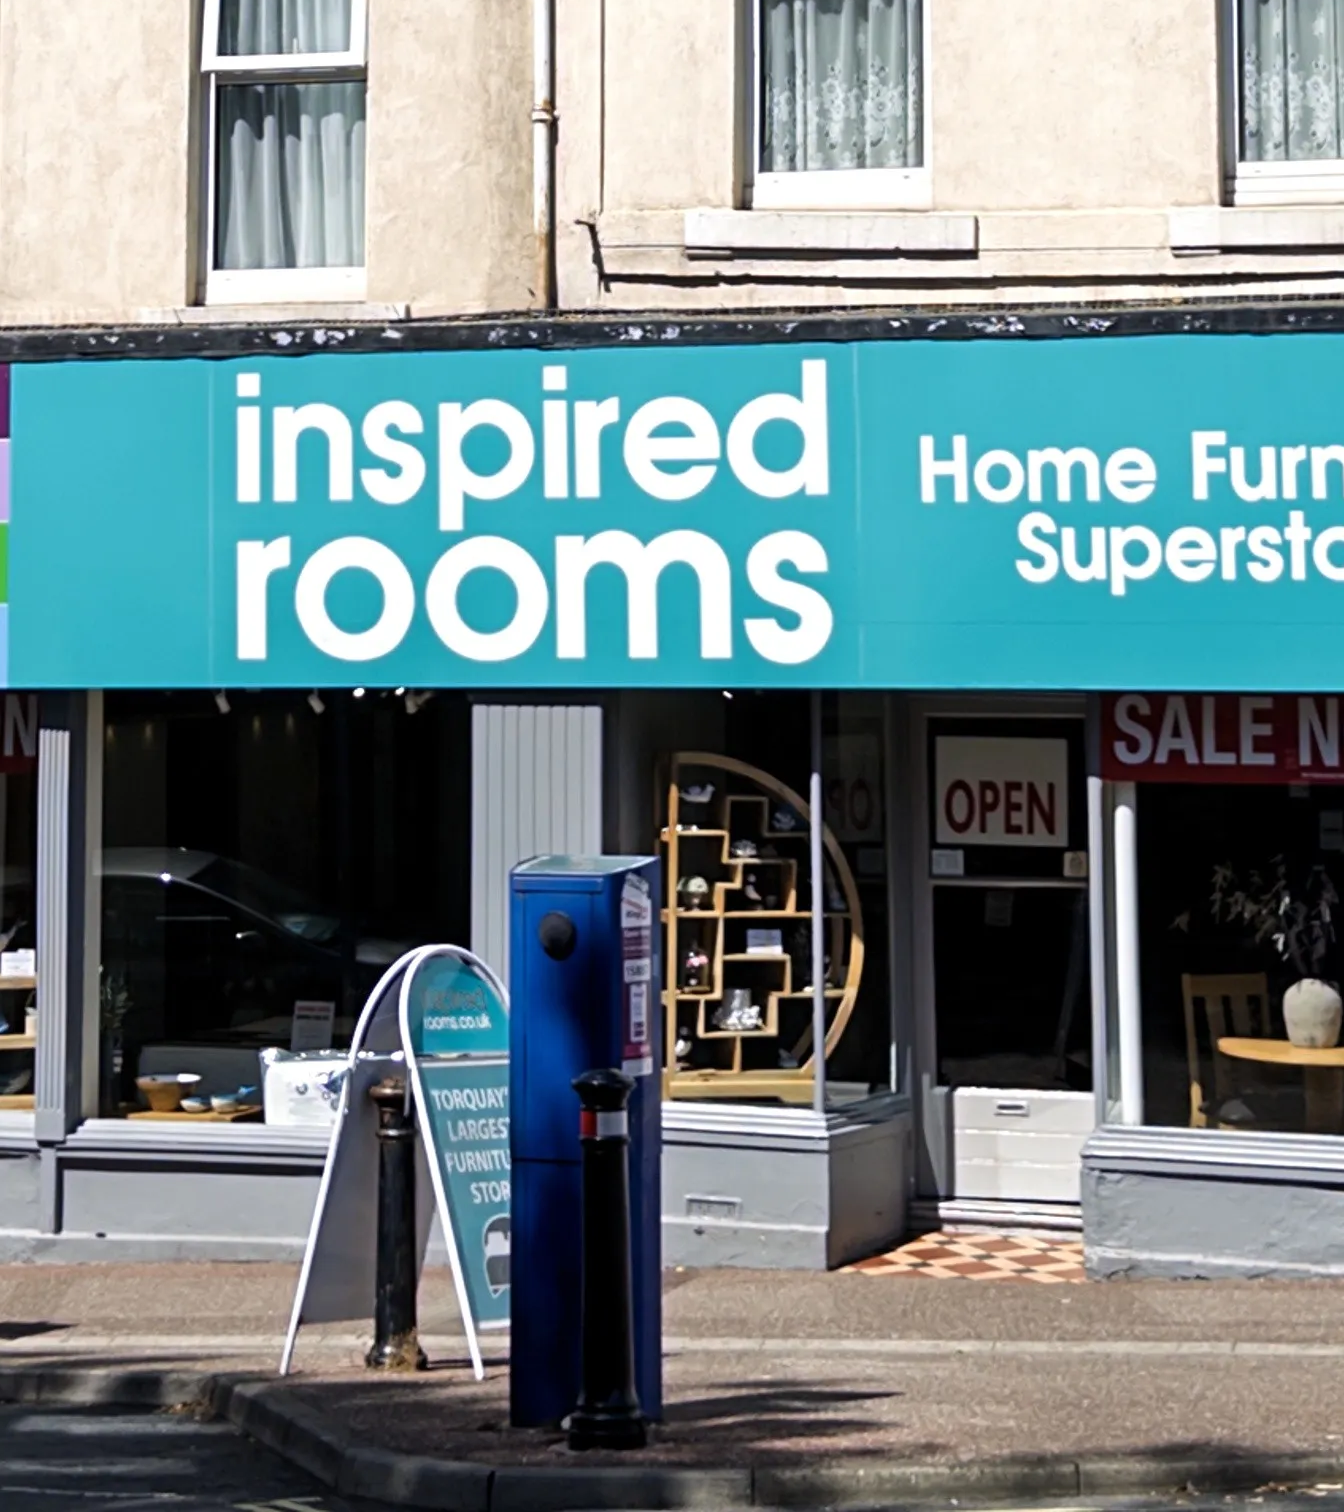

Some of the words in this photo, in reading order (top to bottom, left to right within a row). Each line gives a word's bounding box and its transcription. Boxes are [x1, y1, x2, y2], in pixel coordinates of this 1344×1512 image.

[236, 358, 829, 531] inspired
[919, 434, 1157, 503] Home
[237, 529, 834, 665] rooms
[1113, 695, 1276, 765] SALE
[944, 779, 1056, 835] OPEN
[424, 1013, 492, 1030] rooms.co.uk
[430, 1086, 509, 1111] TORQUAY'
[471, 1179, 510, 1204] STOR
